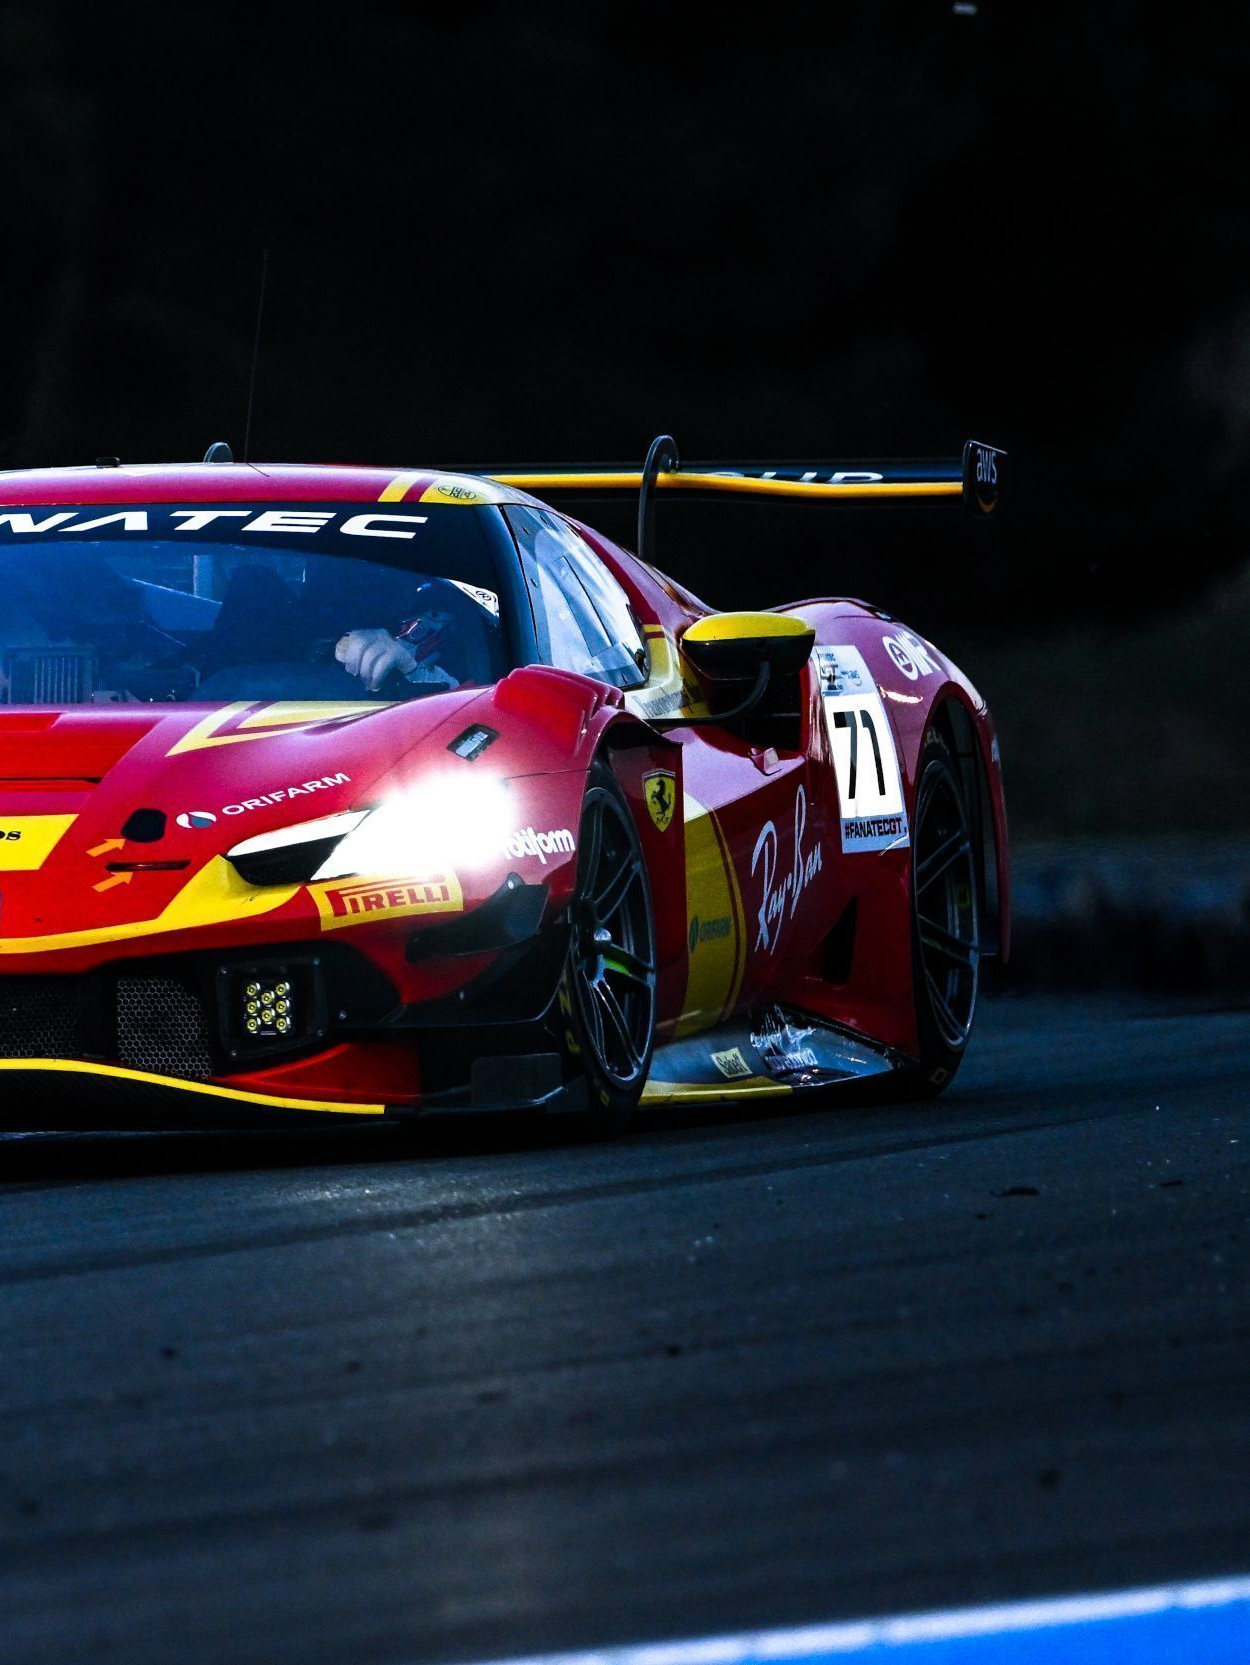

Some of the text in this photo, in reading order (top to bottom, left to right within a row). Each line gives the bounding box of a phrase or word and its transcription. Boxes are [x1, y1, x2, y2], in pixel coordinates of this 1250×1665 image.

[976, 448, 997, 485] aws
[833, 709, 886, 800] 71
[222, 772, 352, 816] ORIFARM
[845, 816, 903, 839] #FANATECGT
[324, 873, 450, 918] PIRELLI
